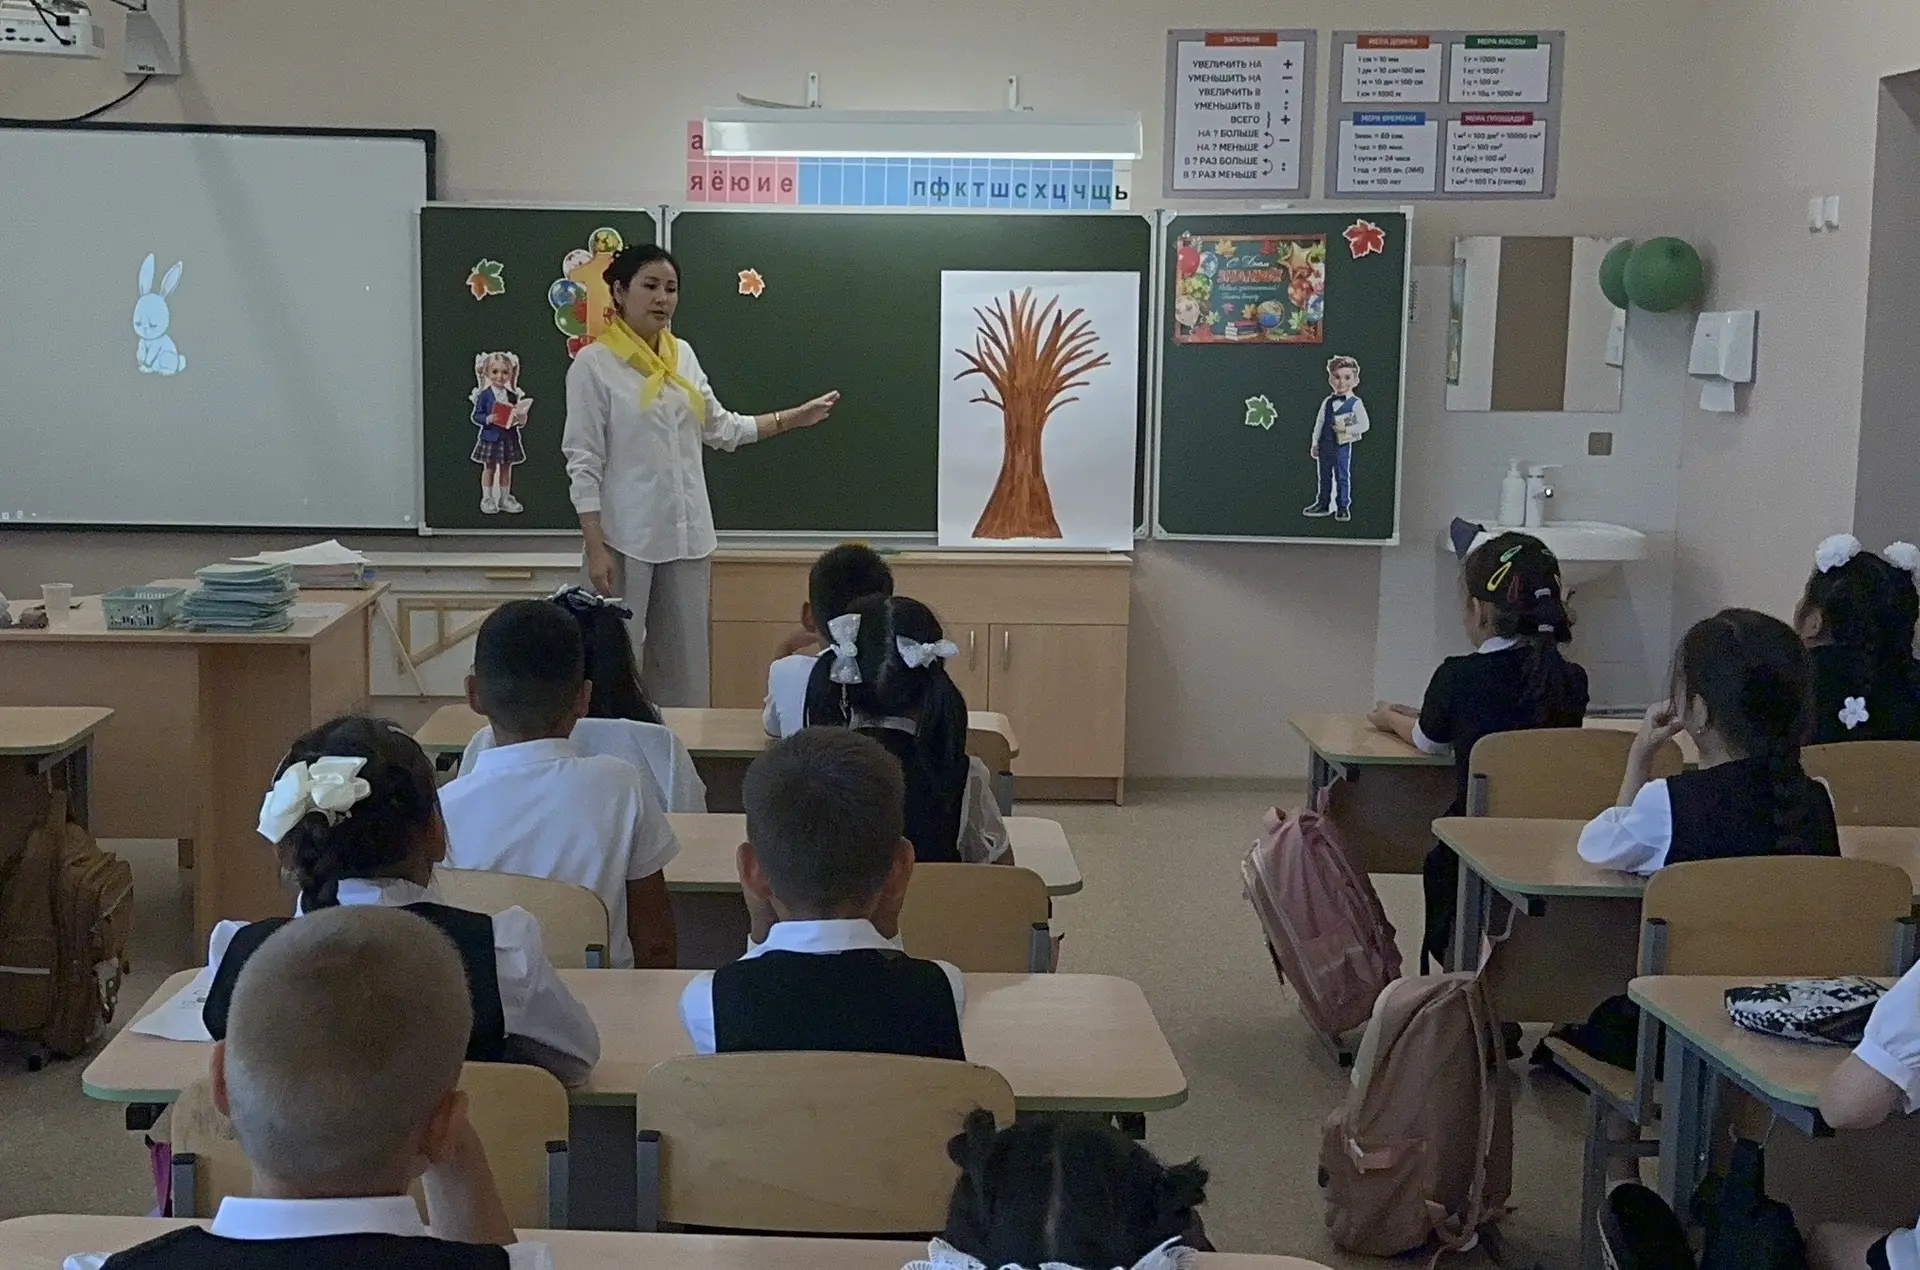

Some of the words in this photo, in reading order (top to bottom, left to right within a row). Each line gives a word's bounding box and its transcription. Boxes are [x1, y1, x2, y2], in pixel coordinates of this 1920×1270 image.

[1192, 60, 1247, 69] УВЕЛИЧИТЬ
[1249, 60, 1262, 69] НА
[1188, 74, 1247, 83] УМЕНЬШИТЬ
[1248, 74, 1262, 83] НА
[1198, 88, 1253, 97] УВЕЛИЧИТЬ
[1255, 88, 1261, 97] В
[1194, 102, 1253, 110] УМЕНЬШИТЬ
[1254, 102, 1261, 110] В
[1230, 115, 1260, 124] ВСЕГО
[1198, 130, 1211, 138] НА
[1214, 130, 1219, 138] ?
[1220, 130, 1260, 138] БОЛЬШЕ
[1196, 143, 1210, 152] НА
[1212, 143, 1217, 152] ?
[1219, 143, 1259, 152] МЕНЬШЕ
[1184, 156, 1190, 165] В
[1193, 156, 1198, 165] ?
[1199, 156, 1218, 165] РАЗ
[1219, 156, 1259, 165] БОЛЬШЕ
[1183, 171, 1189, 179] В
[1192, 171, 1197, 179] ?
[1198, 171, 1216, 179] РАЗ
[1218, 171, 1258, 179] МЕНЬШЕ
